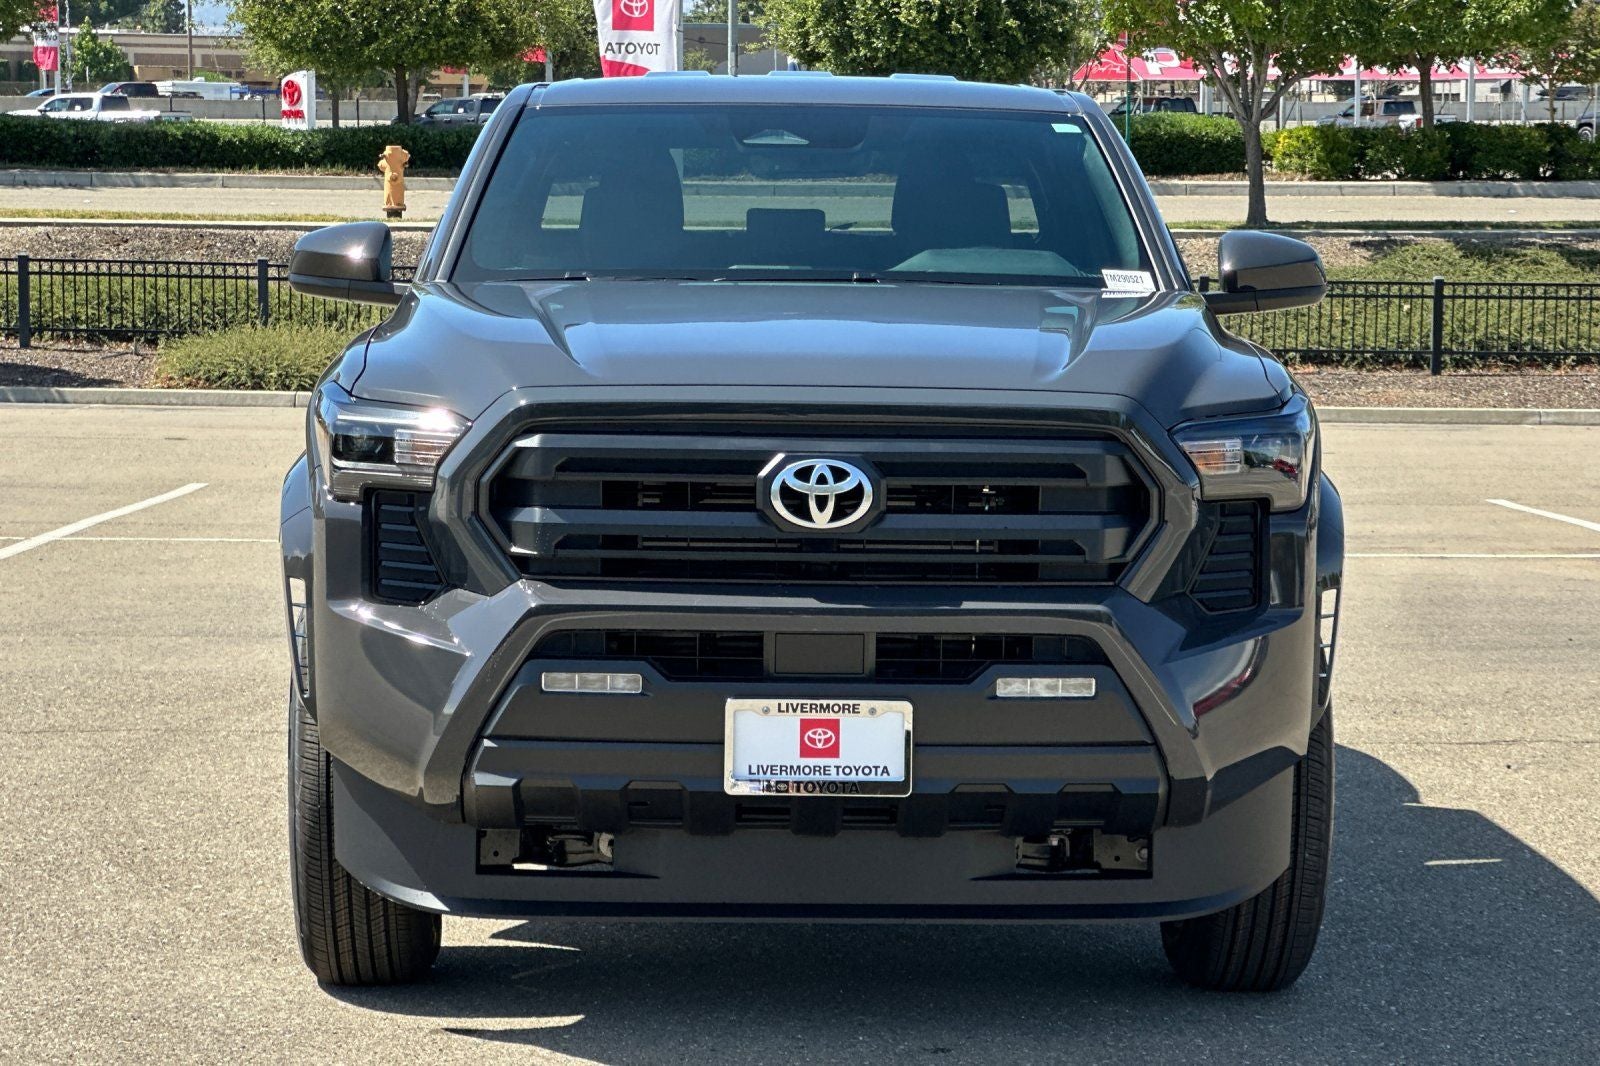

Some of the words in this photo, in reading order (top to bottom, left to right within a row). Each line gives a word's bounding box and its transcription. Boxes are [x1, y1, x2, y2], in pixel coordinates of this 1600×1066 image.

[777, 702, 861, 714] LIVERMORE
[748, 764, 831, 776] LIVERMORE
[835, 765, 890, 777] TOYOTA
[794, 781, 860, 793] TOYOTA
